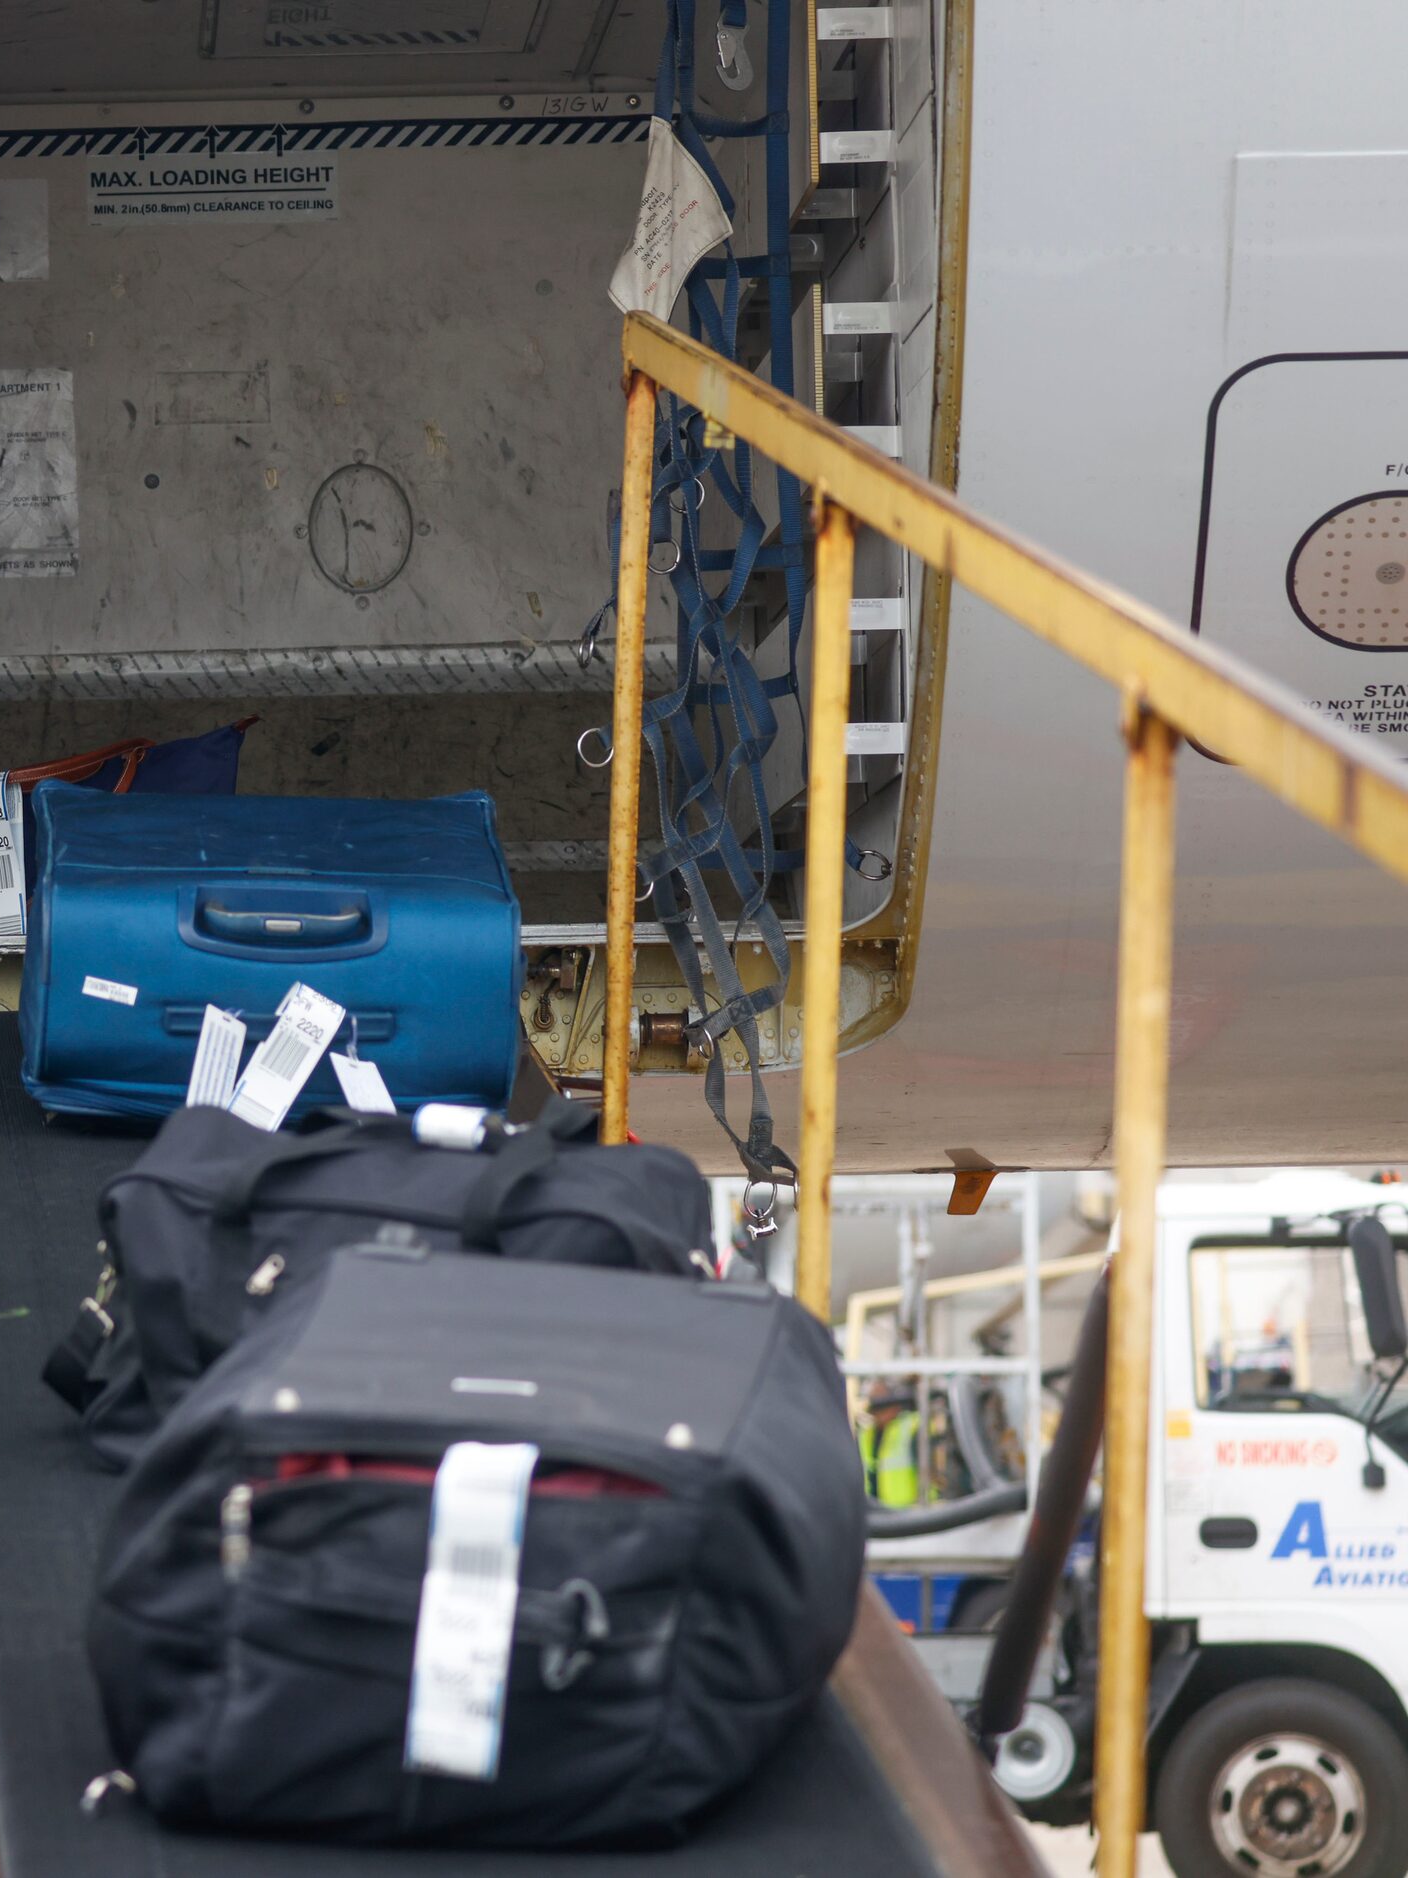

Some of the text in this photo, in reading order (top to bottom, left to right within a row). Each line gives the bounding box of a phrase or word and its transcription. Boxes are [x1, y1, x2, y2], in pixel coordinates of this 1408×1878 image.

[90, 166, 334, 188] MAX. LOADING HEIGHT
[94, 205, 118, 215] MIN.
[194, 201, 265, 212] CLEARANCE
[269, 201, 284, 211] TO
[288, 199, 334, 211] CEILING
[679, 199, 698, 220] DOOR
[634, 245, 644, 256] PN
[641, 252, 650, 262] SN
[647, 252, 662, 270] DATE
[56, 383, 61, 391] 1
[24, 560, 35, 569] AS
[39, 559, 73, 568] SHOWN
[1328, 700, 1365, 709] NOT
[295, 1016, 325, 1040] 2220
[1216, 1440, 1308, 1466] NO SMOKING
[1271, 1500, 1396, 1559] ALLIED
